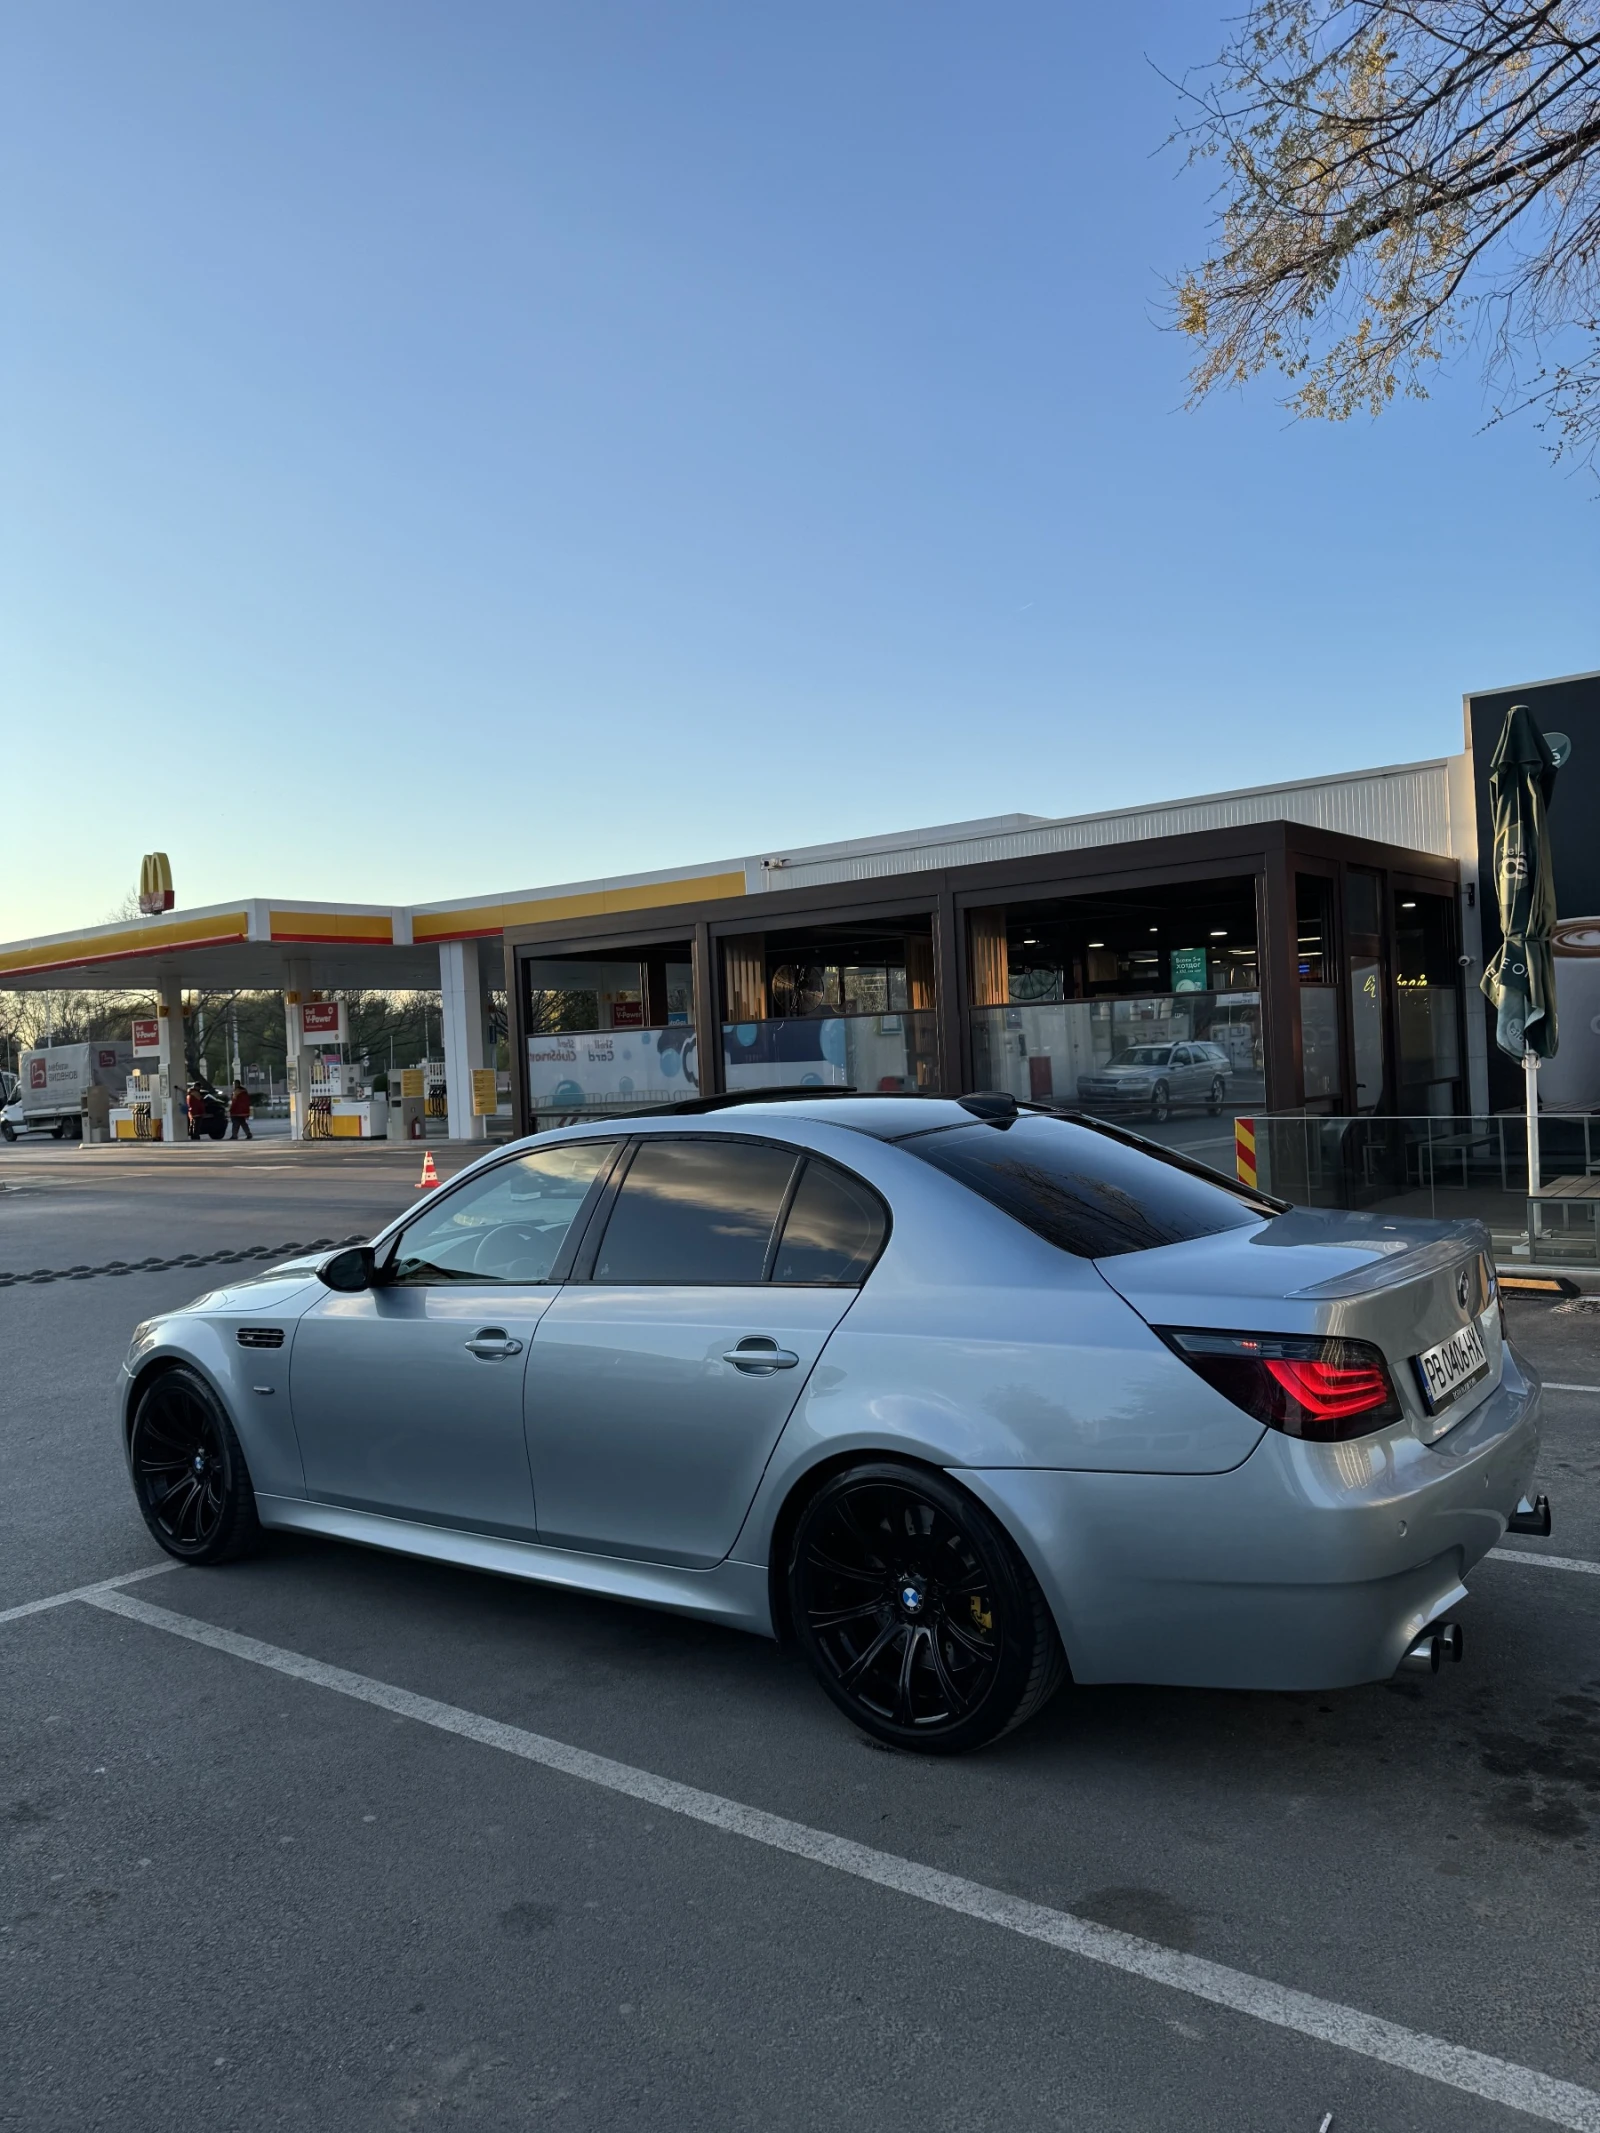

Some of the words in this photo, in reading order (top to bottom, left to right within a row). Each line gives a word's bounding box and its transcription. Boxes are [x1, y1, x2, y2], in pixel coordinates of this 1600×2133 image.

[616, 1011, 642, 1019] V-Power
[305, 1015, 332, 1024] V-Power
[136, 1031, 157, 1039] V-Power
[1424, 1353, 1446, 1394] PB
[1441, 1336, 1470, 1381] 0406
[1463, 1327, 1484, 1365] HX
